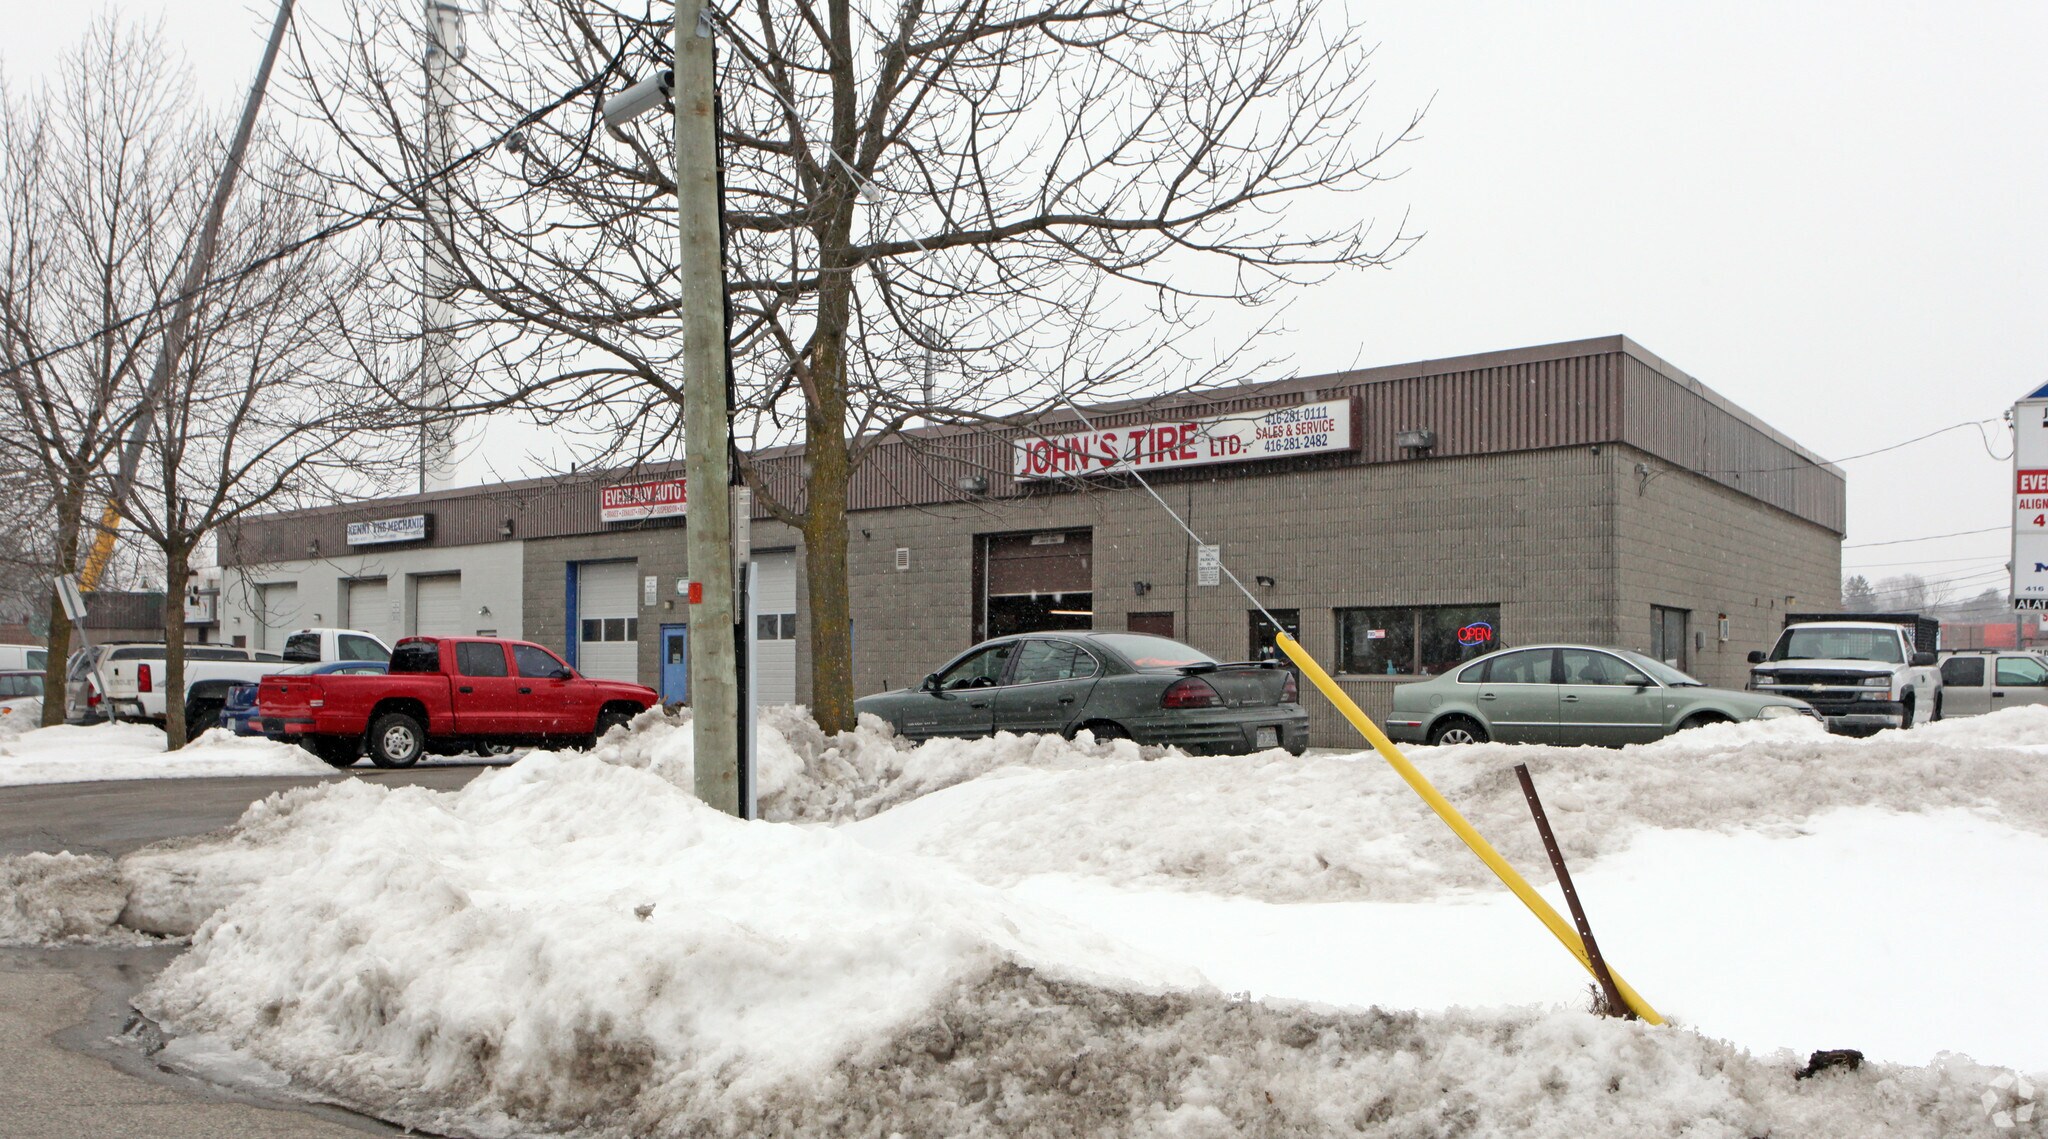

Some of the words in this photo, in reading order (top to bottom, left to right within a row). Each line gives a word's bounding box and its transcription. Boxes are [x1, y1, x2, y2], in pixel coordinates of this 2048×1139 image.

[1265, 406, 1328, 426] 416-281-0111
[1256, 425, 1284, 440] SALES
[1286, 424, 1293, 437] &
[1295, 419, 1335, 436] SERVICE
[1021, 432, 1118, 475] JOHN'S
[1129, 423, 1198, 465] TIRE
[1210, 434, 1248, 457] LTD.
[1264, 434, 1328, 452] 416-281-2482
[655, 483, 681, 501] AUTO
[387, 516, 425, 532] MECHANIC
[1457, 627, 1492, 641] OPEN
